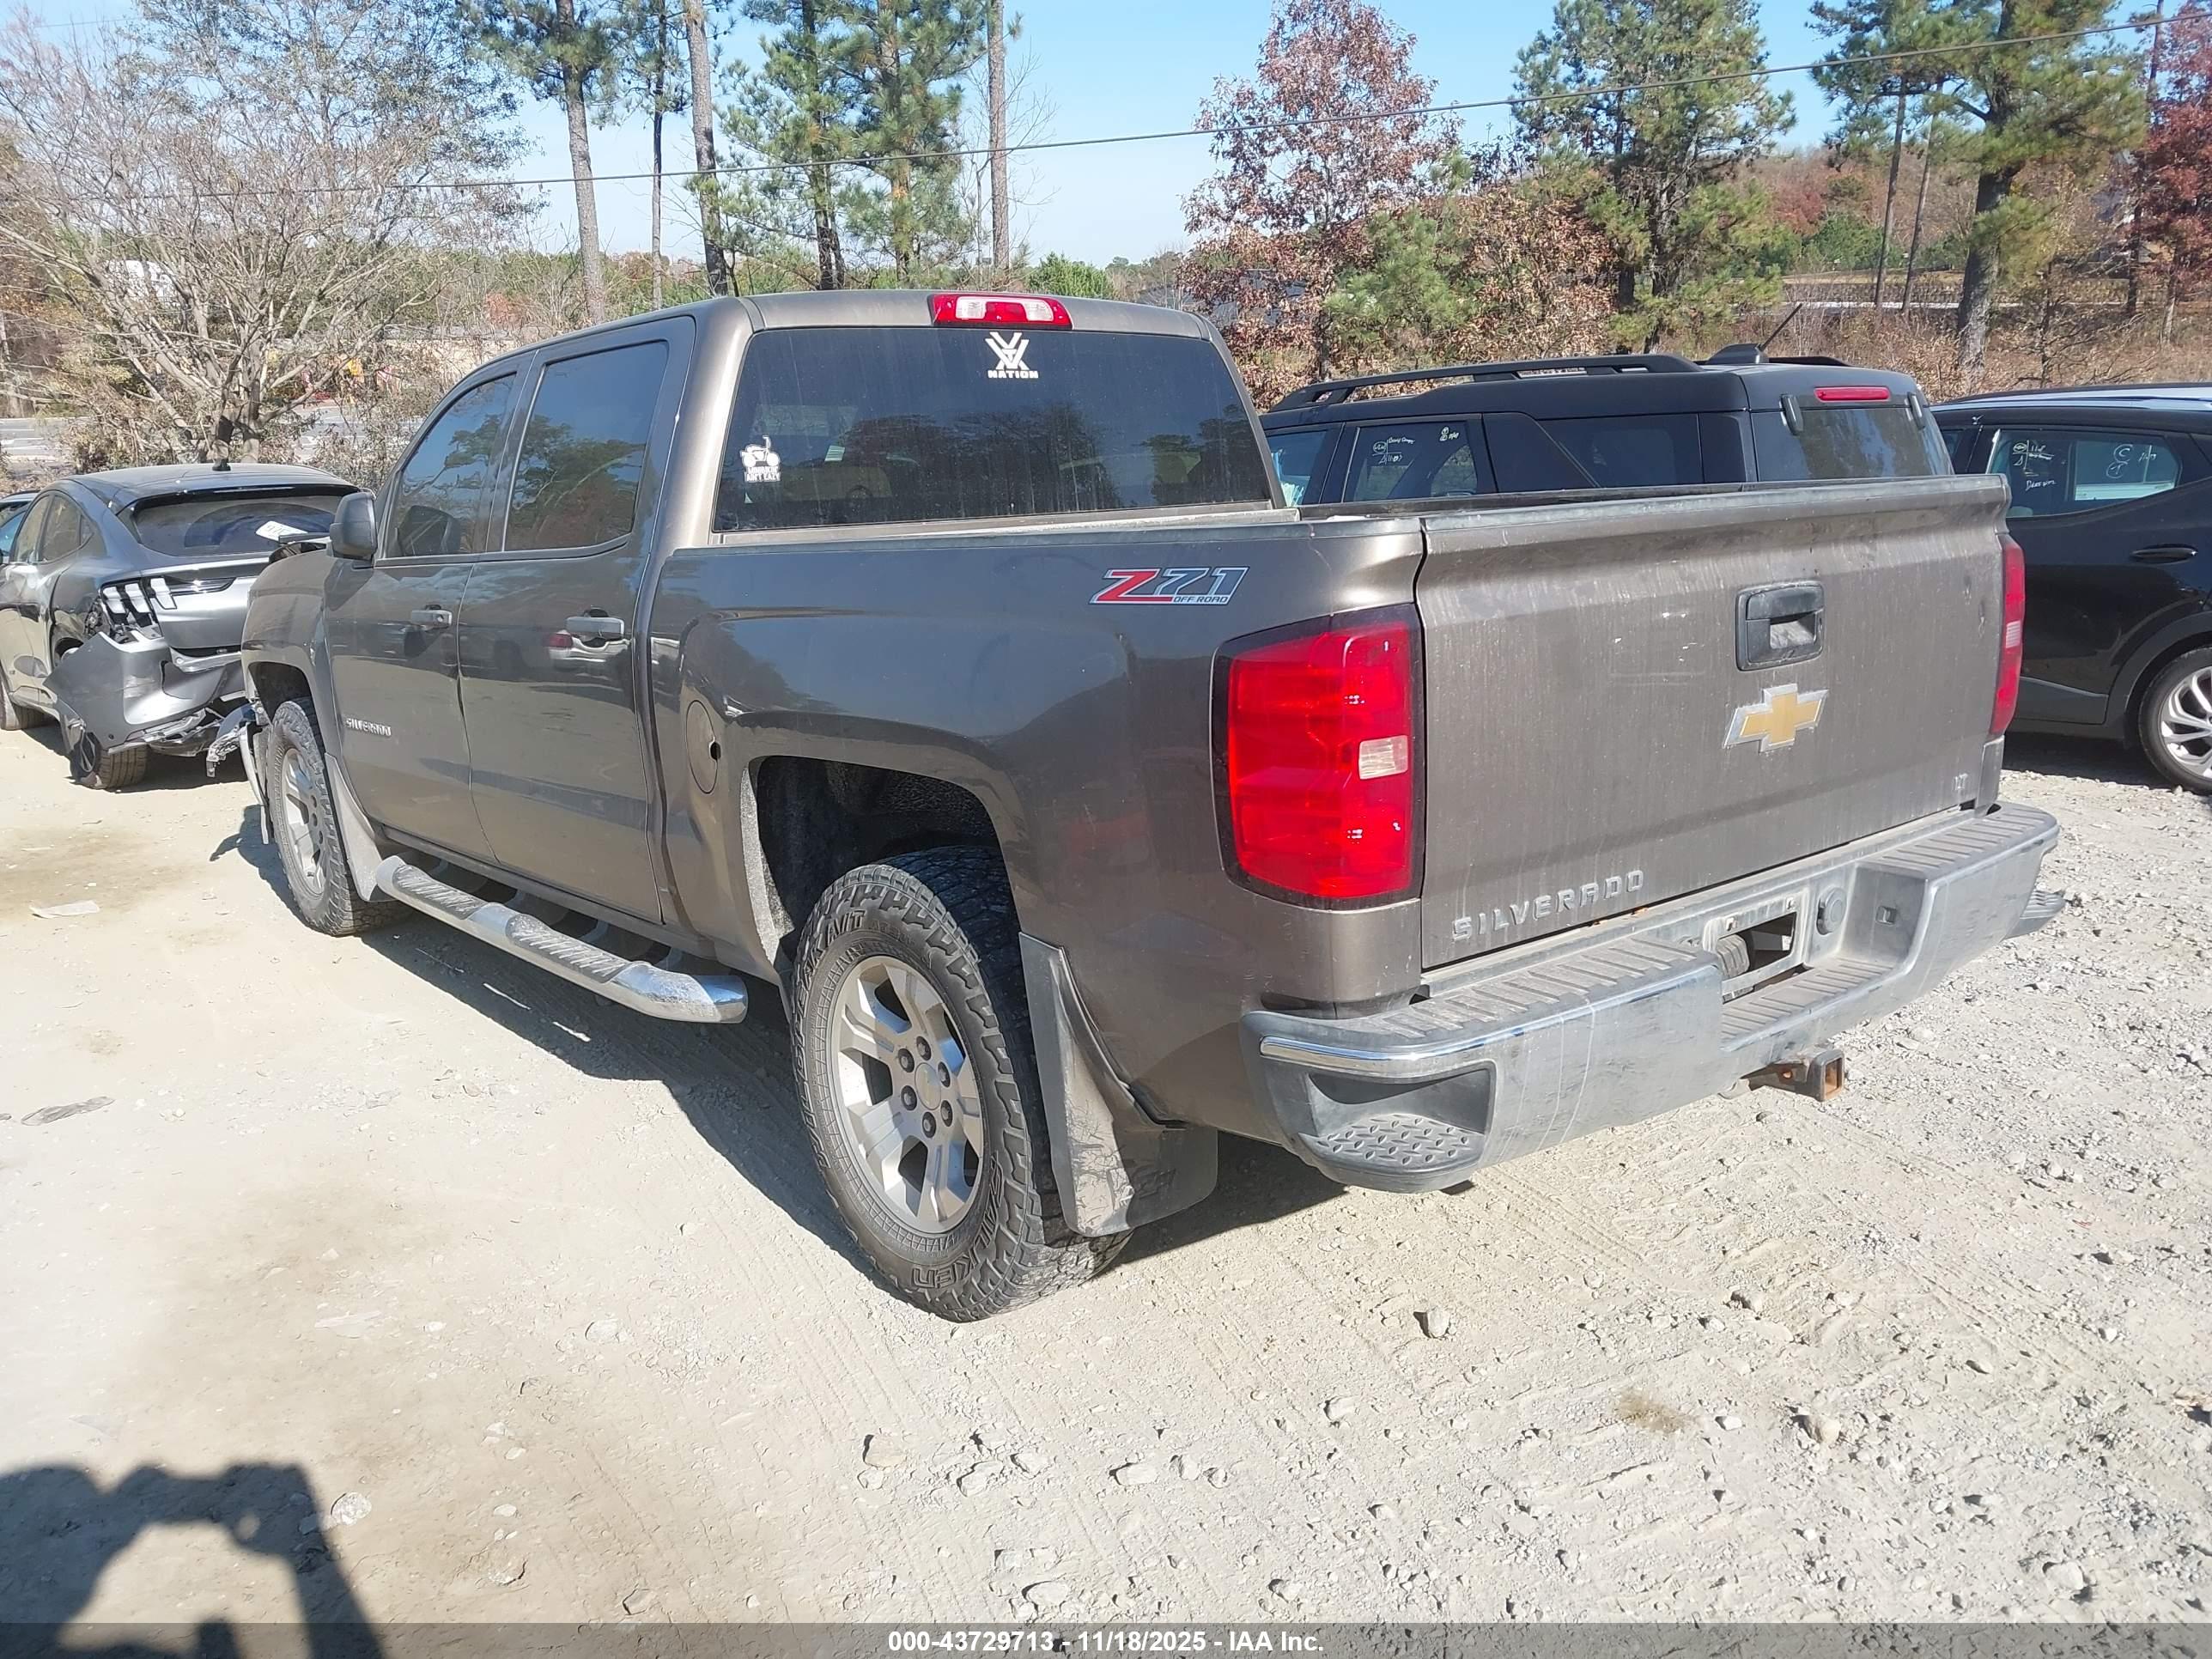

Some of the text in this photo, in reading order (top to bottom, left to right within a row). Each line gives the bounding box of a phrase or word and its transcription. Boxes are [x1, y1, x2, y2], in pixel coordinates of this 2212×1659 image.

[1089, 567, 1249, 605] Z71
[345, 718, 392, 737] SILVERADO
[1453, 869, 1644, 941] SILVERADO
